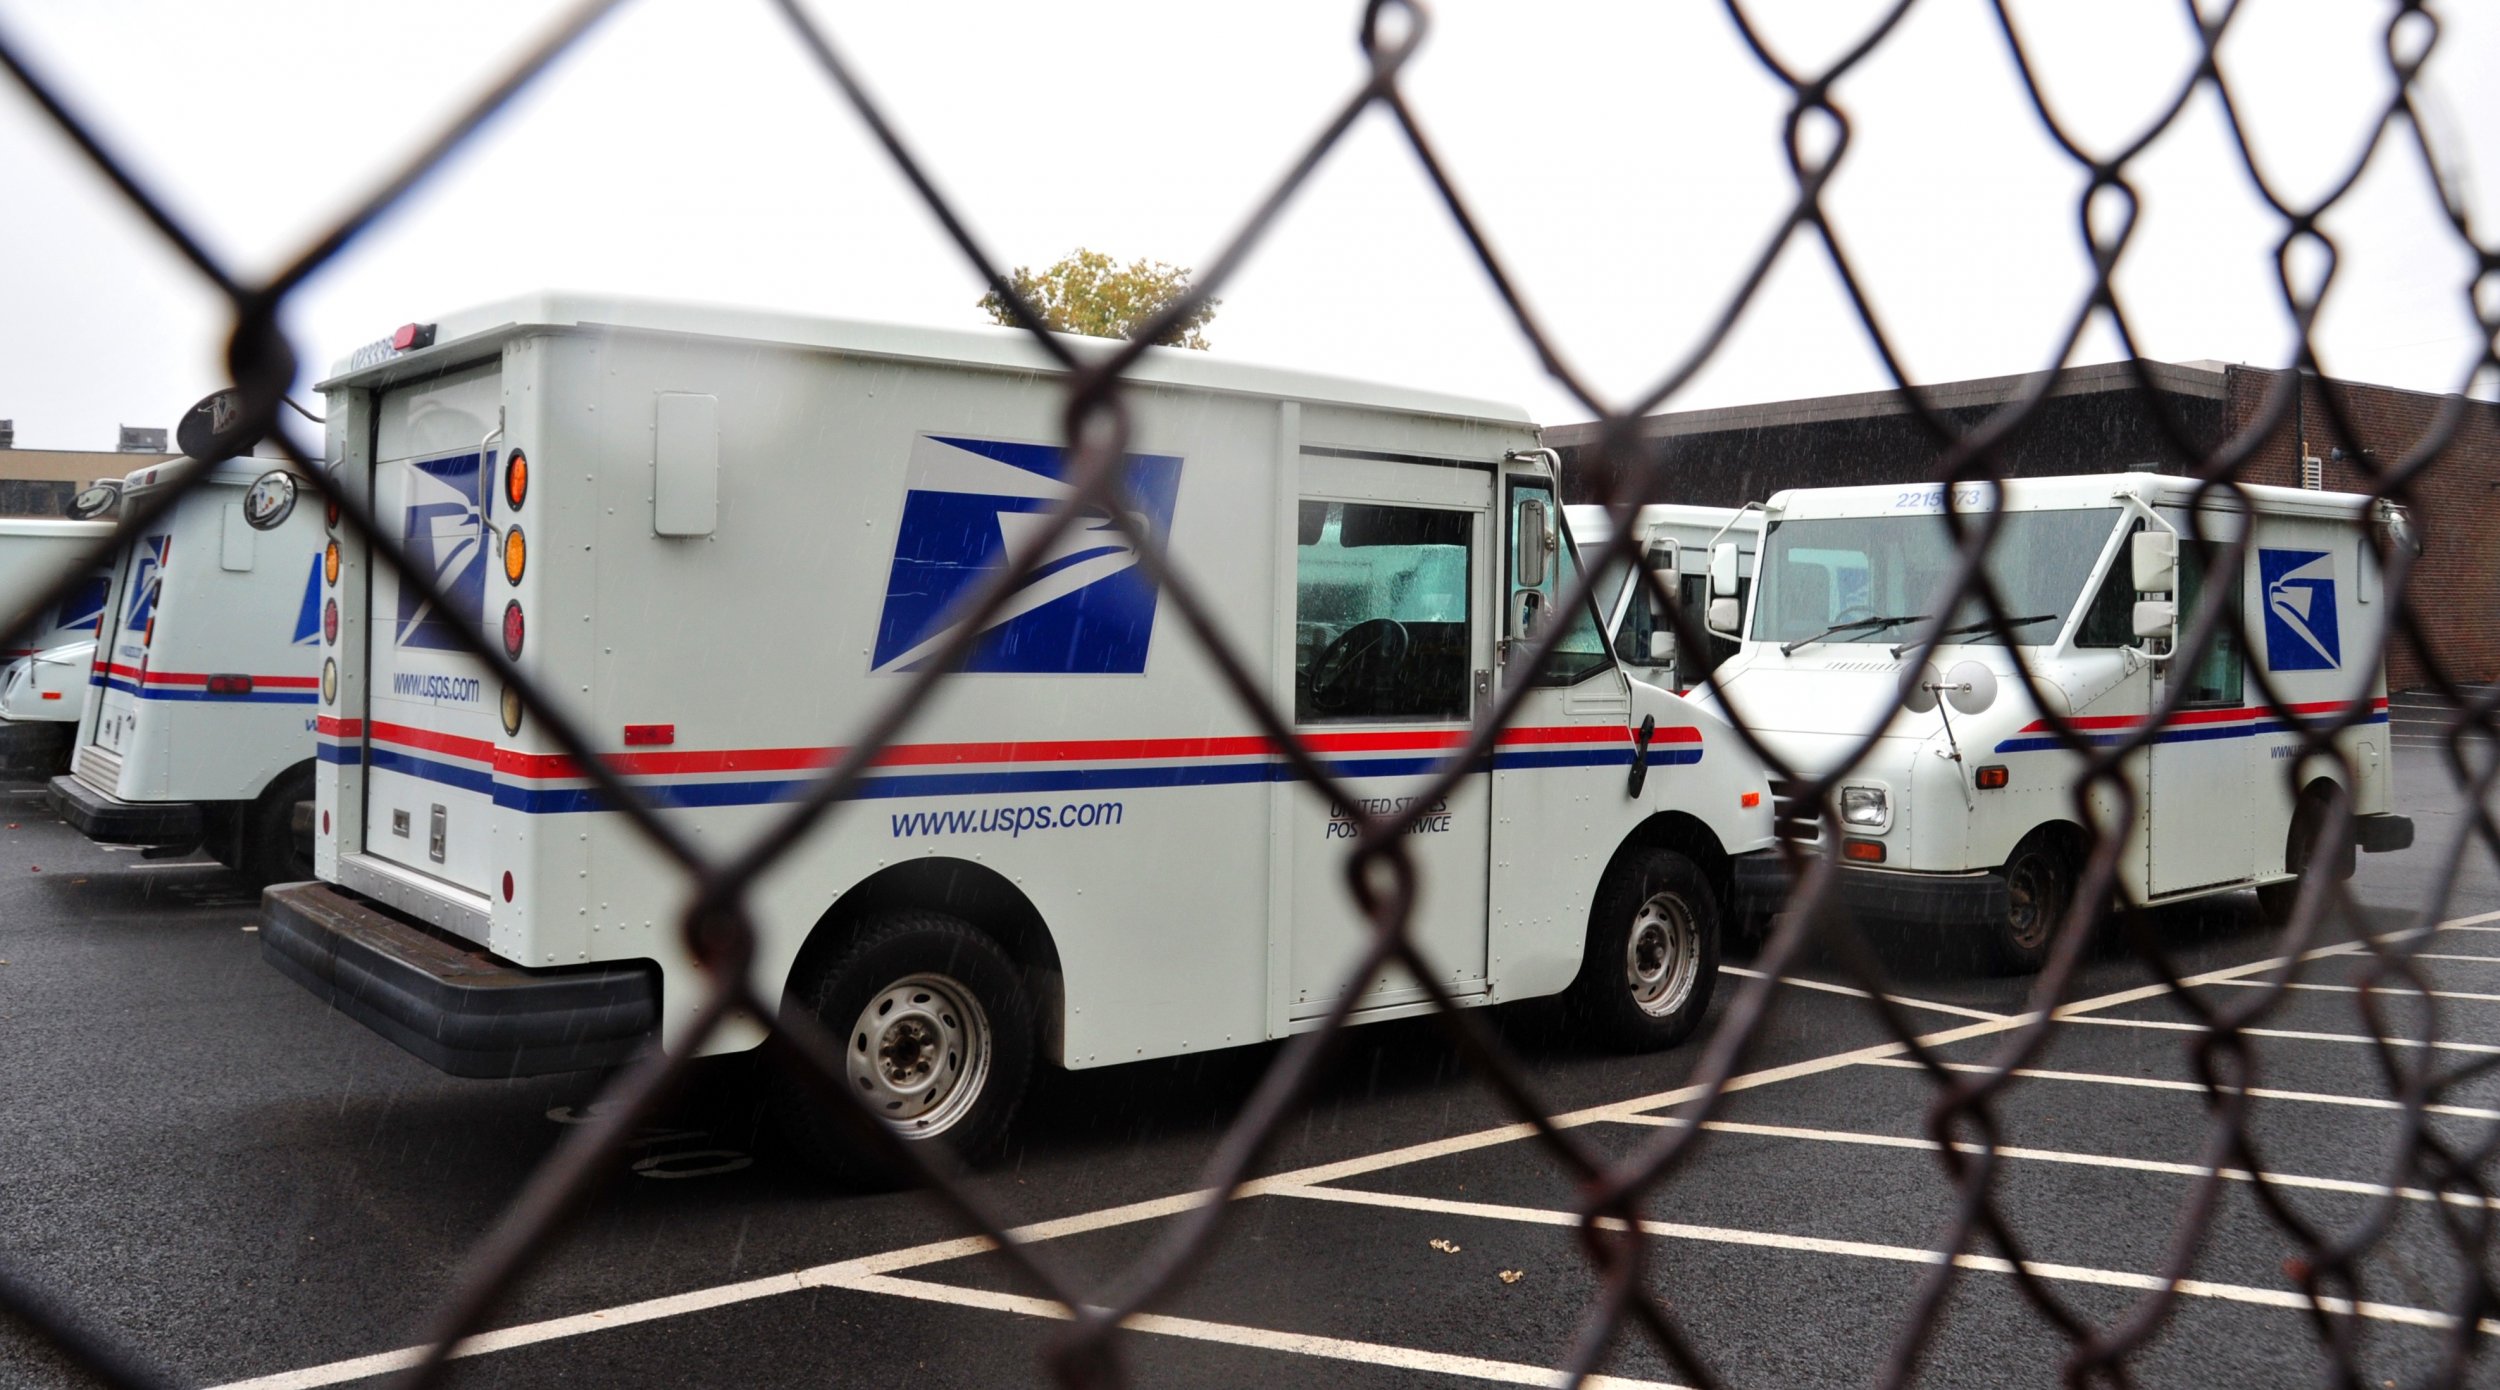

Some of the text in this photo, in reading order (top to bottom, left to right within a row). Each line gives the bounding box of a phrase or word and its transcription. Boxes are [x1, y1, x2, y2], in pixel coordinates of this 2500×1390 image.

[393, 671, 480, 706] www.usps.com
[1393, 795, 1448, 815] STES
[891, 801, 1123, 839] www.usps.com
[1391, 815, 1451, 835] RVICE
